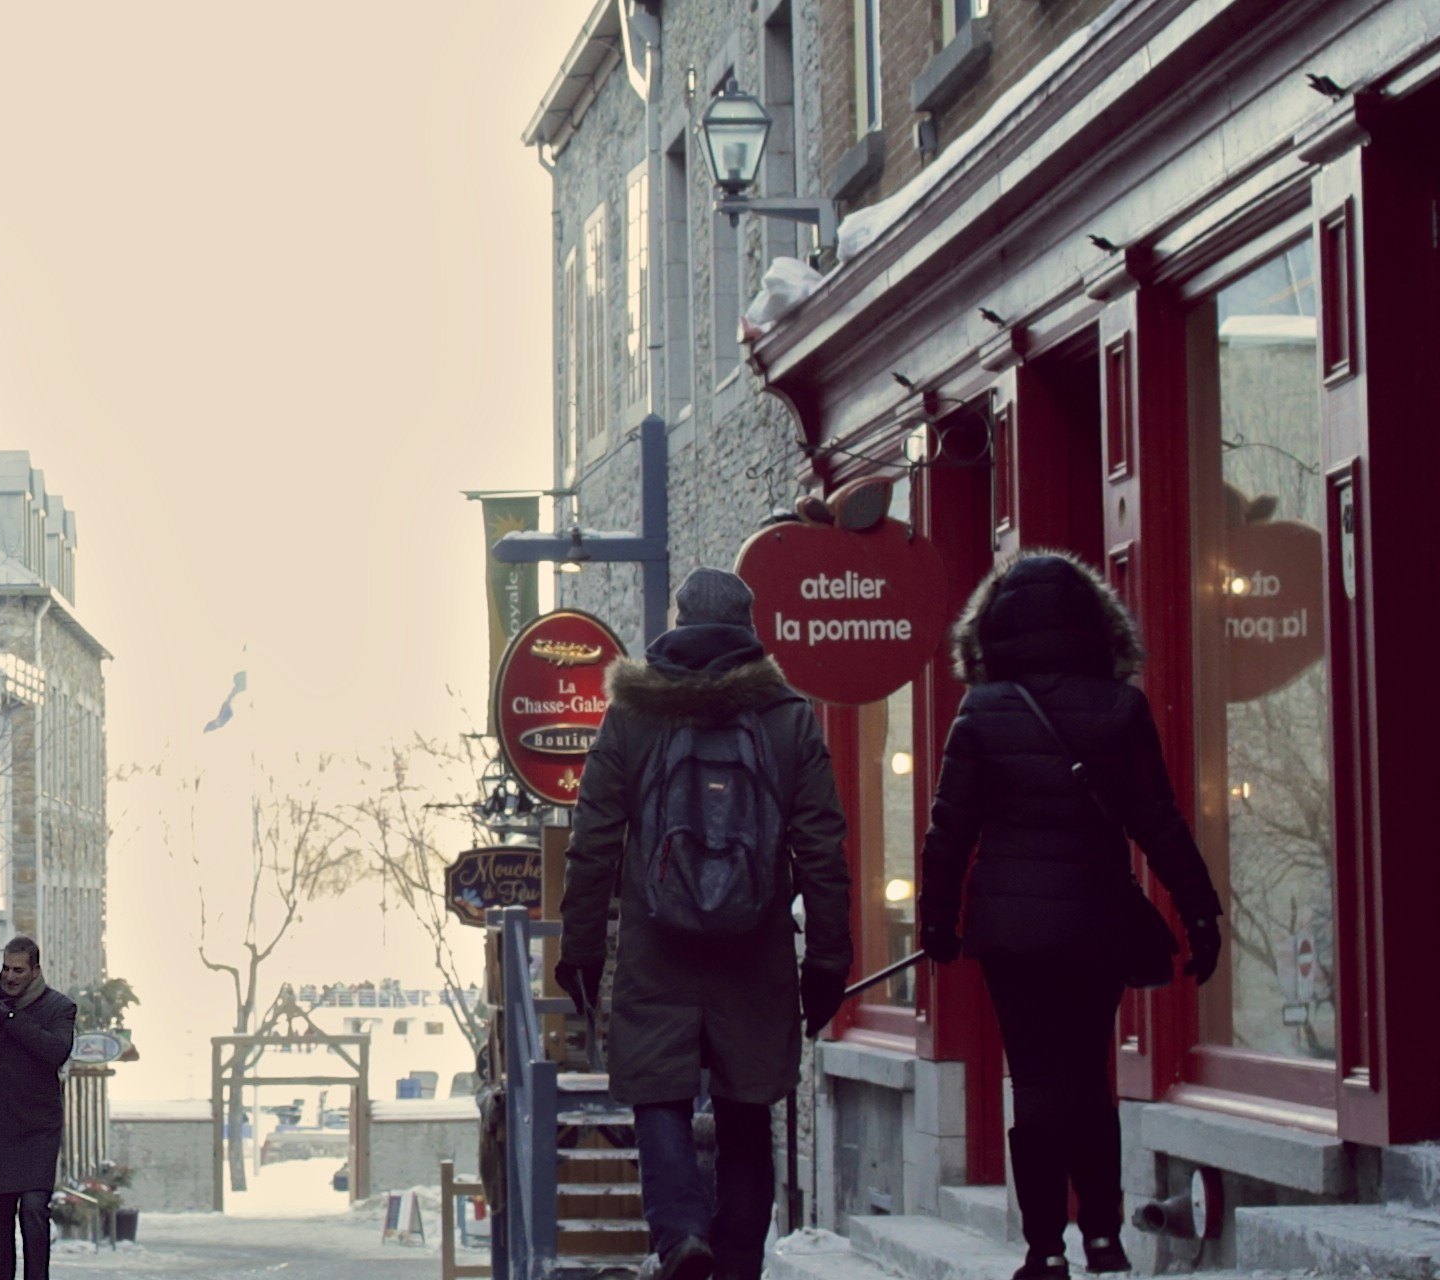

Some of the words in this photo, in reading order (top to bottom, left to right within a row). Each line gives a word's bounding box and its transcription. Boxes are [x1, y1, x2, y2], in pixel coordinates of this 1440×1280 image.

[799, 571, 886, 601] atelier
[504, 571, 521, 645] oyale
[775, 611, 801, 642] la
[807, 617, 913, 647] pomme
[558, 678, 577, 695] La
